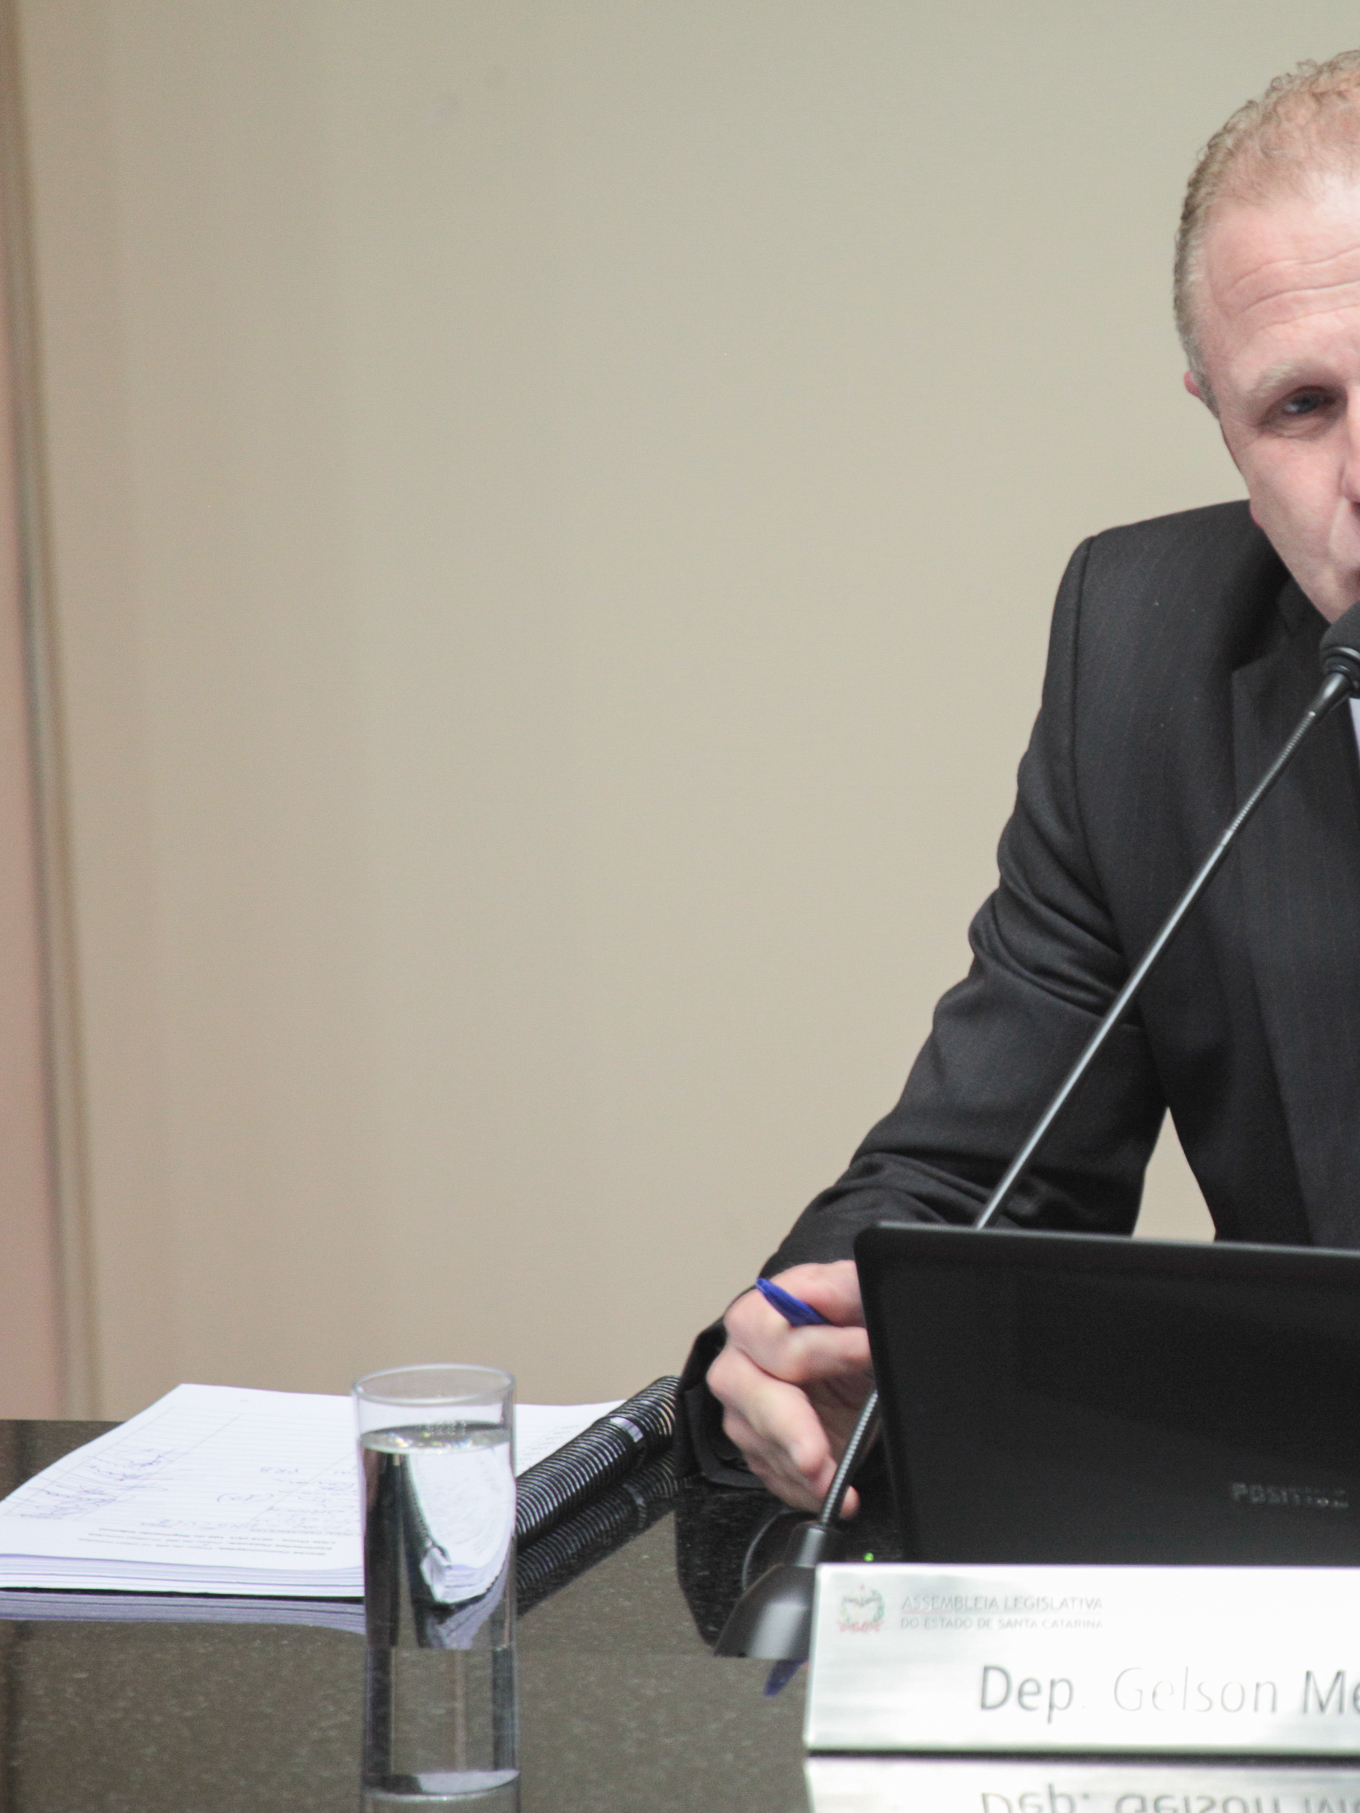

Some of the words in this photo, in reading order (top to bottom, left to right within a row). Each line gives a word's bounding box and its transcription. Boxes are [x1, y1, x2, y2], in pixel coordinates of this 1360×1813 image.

[901, 1595, 999, 1611] ASSEMBLEIA
[1004, 1595, 1103, 1611] LEGISLATIVA
[901, 1617, 919, 1629] DO
[924, 1617, 973, 1629] ESTADO
[977, 1617, 992, 1629] DE
[998, 1617, 1037, 1629] SANTA
[1042, 1617, 1103, 1629] CATARINA
[1114, 1666, 1276, 1713] Gelson
